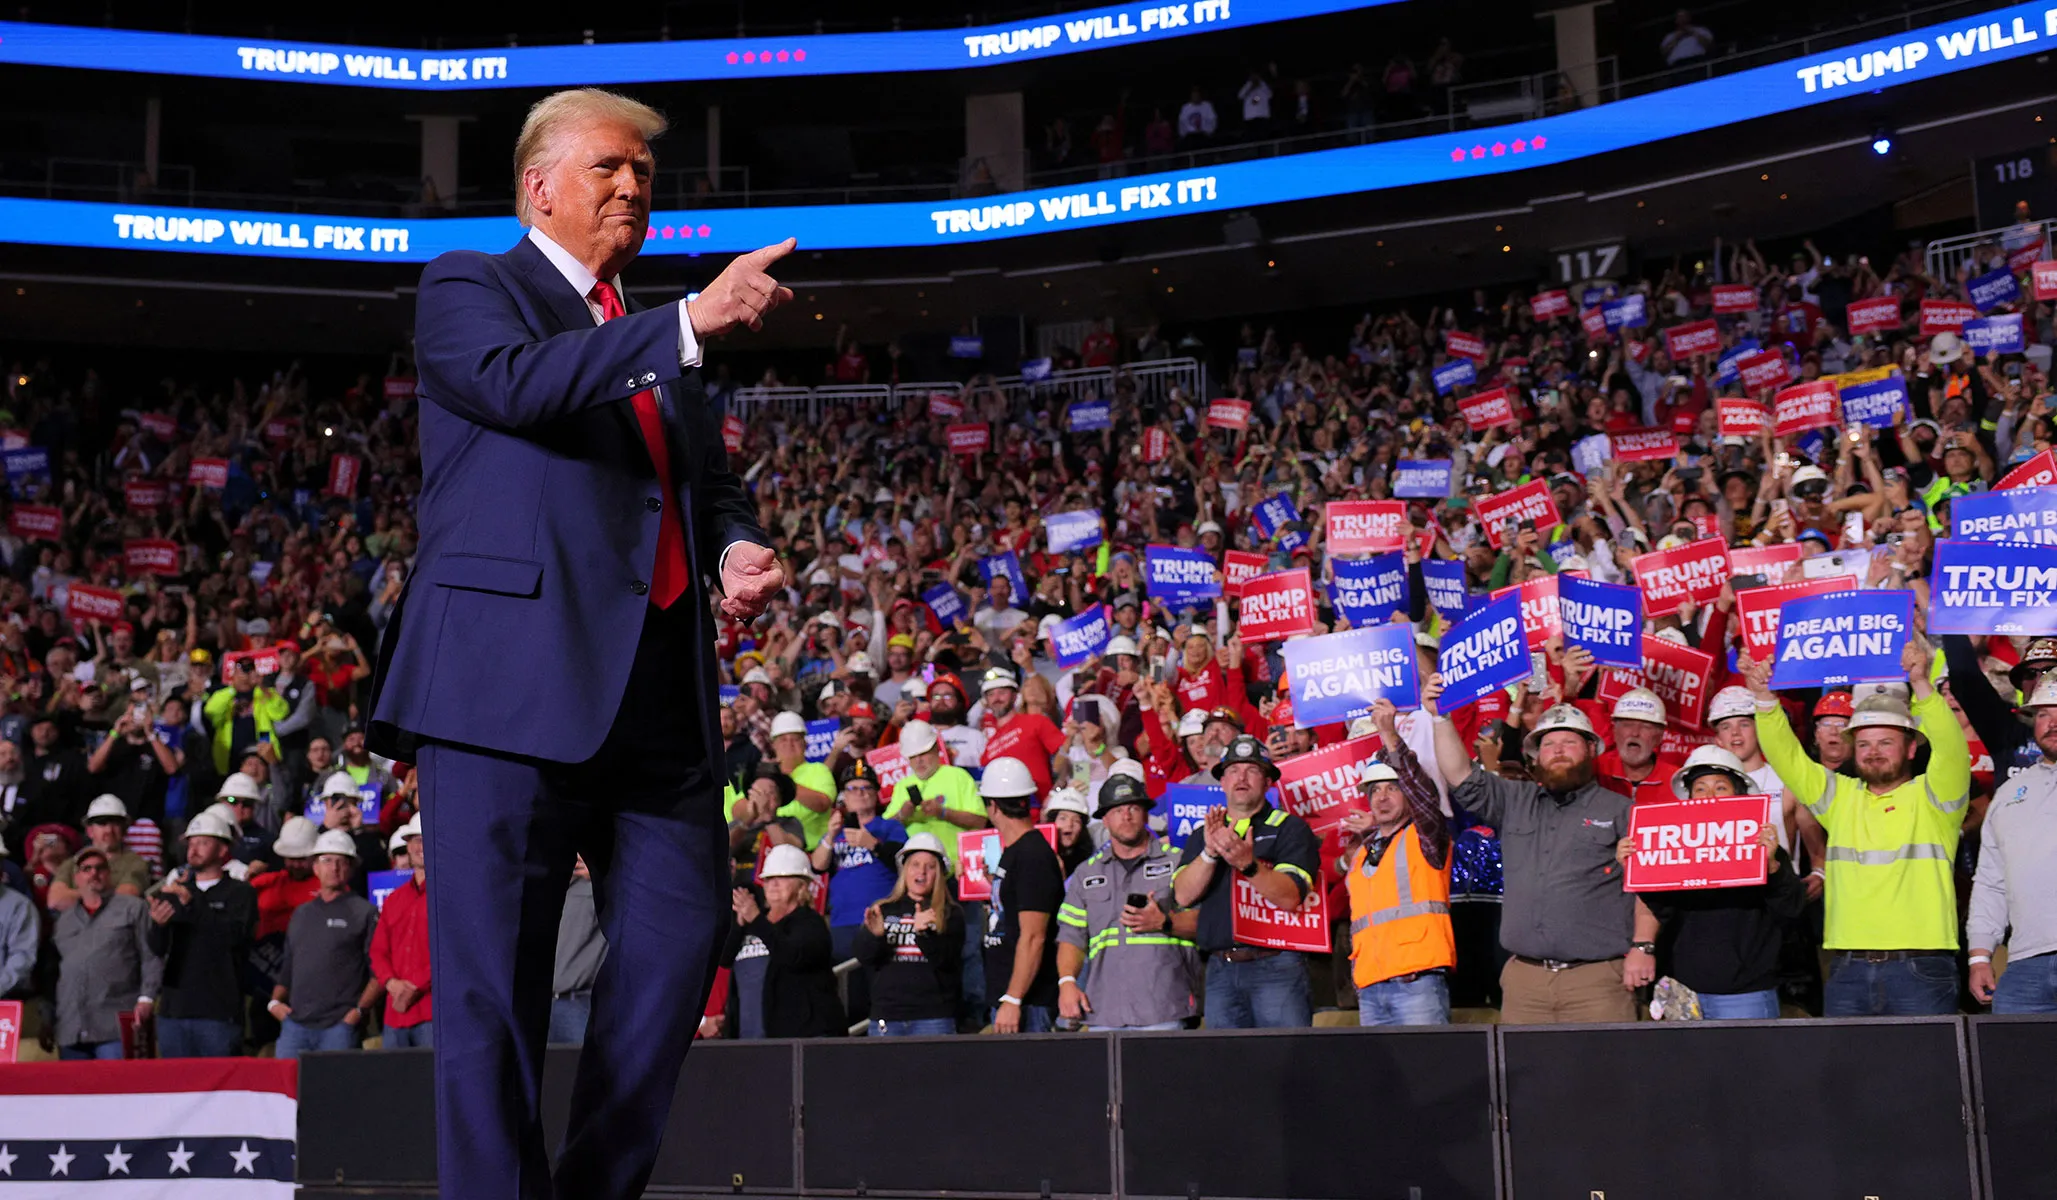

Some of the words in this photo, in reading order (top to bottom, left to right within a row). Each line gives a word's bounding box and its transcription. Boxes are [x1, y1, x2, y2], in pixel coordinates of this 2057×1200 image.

[965, 25, 1060, 58] TRUMP
[1067, 13, 1136, 43] WILL
[1141, 3, 1188, 32] FIX
[1194, 0, 1230, 22] IT!
[237, 46, 338, 75] TRUMP
[344, 49, 417, 80] WILL
[421, 49, 466, 81] FIX
[472, 47, 507, 80] IT!
[1797, 42, 1929, 93] TRUMP
[1935, 16, 2038, 61] WILL
[1993, 158, 2034, 183] 118
[931, 201, 1034, 234] TRUMP
[1039, 189, 1116, 221] WILL
[1121, 182, 1170, 211] FIX
[1176, 177, 1217, 203] IT!
[113, 213, 225, 244] TRUMP
[229, 219, 308, 249] WILL
[314, 225, 363, 251] FIX
[370, 227, 409, 252] IT!
[1557, 246, 1621, 282] 117
[1966, 324, 2020, 339] TRUMP
[1776, 402, 1832, 423] AGAIN!
[1843, 389, 1903, 411] TRUMP
[1615, 431, 1671, 444] TRUMP
[1331, 513, 1401, 529] TRUMP
[1482, 501, 1522, 523] DREAM
[1960, 512, 2037, 535] DREAM
[1332, 528, 1366, 540] WILL
[1369, 527, 1392, 538] FIX
[1151, 559, 1217, 576] TRUMP
[1152, 573, 1181, 584] WILL
[1228, 562, 1261, 578] TRU
[1379, 569, 1404, 587] BIG,
[1640, 555, 1726, 589] TRUMP
[1942, 565, 2057, 591] TRUM
[1646, 583, 1687, 602] WILL
[1687, 576, 1713, 593] FIX
[1713, 571, 1728, 586] IT
[1941, 589, 2004, 608] WILL
[2010, 589, 2052, 608] FIX
[1241, 588, 1307, 613] TRUMP
[1520, 595, 1559, 620] RUM
[1240, 611, 1267, 627] WILL
[1269, 607, 1291, 624] FIX
[1292, 603, 1308, 618] IT
[1559, 597, 1634, 631] TRUMP
[1783, 613, 1854, 638] DREAM
[1858, 612, 1904, 633] BIG,
[1055, 617, 1105, 649] TRUMP
[1441, 616, 1518, 672] TRUMP
[1581, 626, 1611, 645] FIX
[1614, 631, 1633, 647] IT
[1748, 625, 1779, 645] WI
[1780, 632, 1893, 663] AGAIN!
[1296, 652, 1364, 679] DREAM
[1368, 647, 1410, 665] BIG,
[1441, 662, 1479, 689] WILL
[1478, 648, 1504, 672] FIX
[1504, 638, 1520, 659] IT
[1302, 665, 1404, 702] AGAIN!
[1612, 669, 1647, 689] WILL
[1653, 683, 1677, 702] FIX
[1680, 690, 1697, 708] IT
[1823, 675, 1849, 684] 2024
[1621, 700, 1655, 709] TRUMP
[1285, 757, 1370, 802] TRUM
[1293, 793, 1340, 817] WILL
[1340, 785, 1365, 804] FI
[1636, 819, 1759, 850] TRUMP
[1636, 849, 1691, 866] WILL
[1695, 845, 1731, 863] FIX
[1735, 843, 1757, 861] IT
[1682, 878, 1708, 887] 2024
[1238, 903, 1271, 923] WILL
[1274, 910, 1302, 928] FIX
[1304, 913, 1321, 929] IT
[886, 933, 917, 946] GIR
